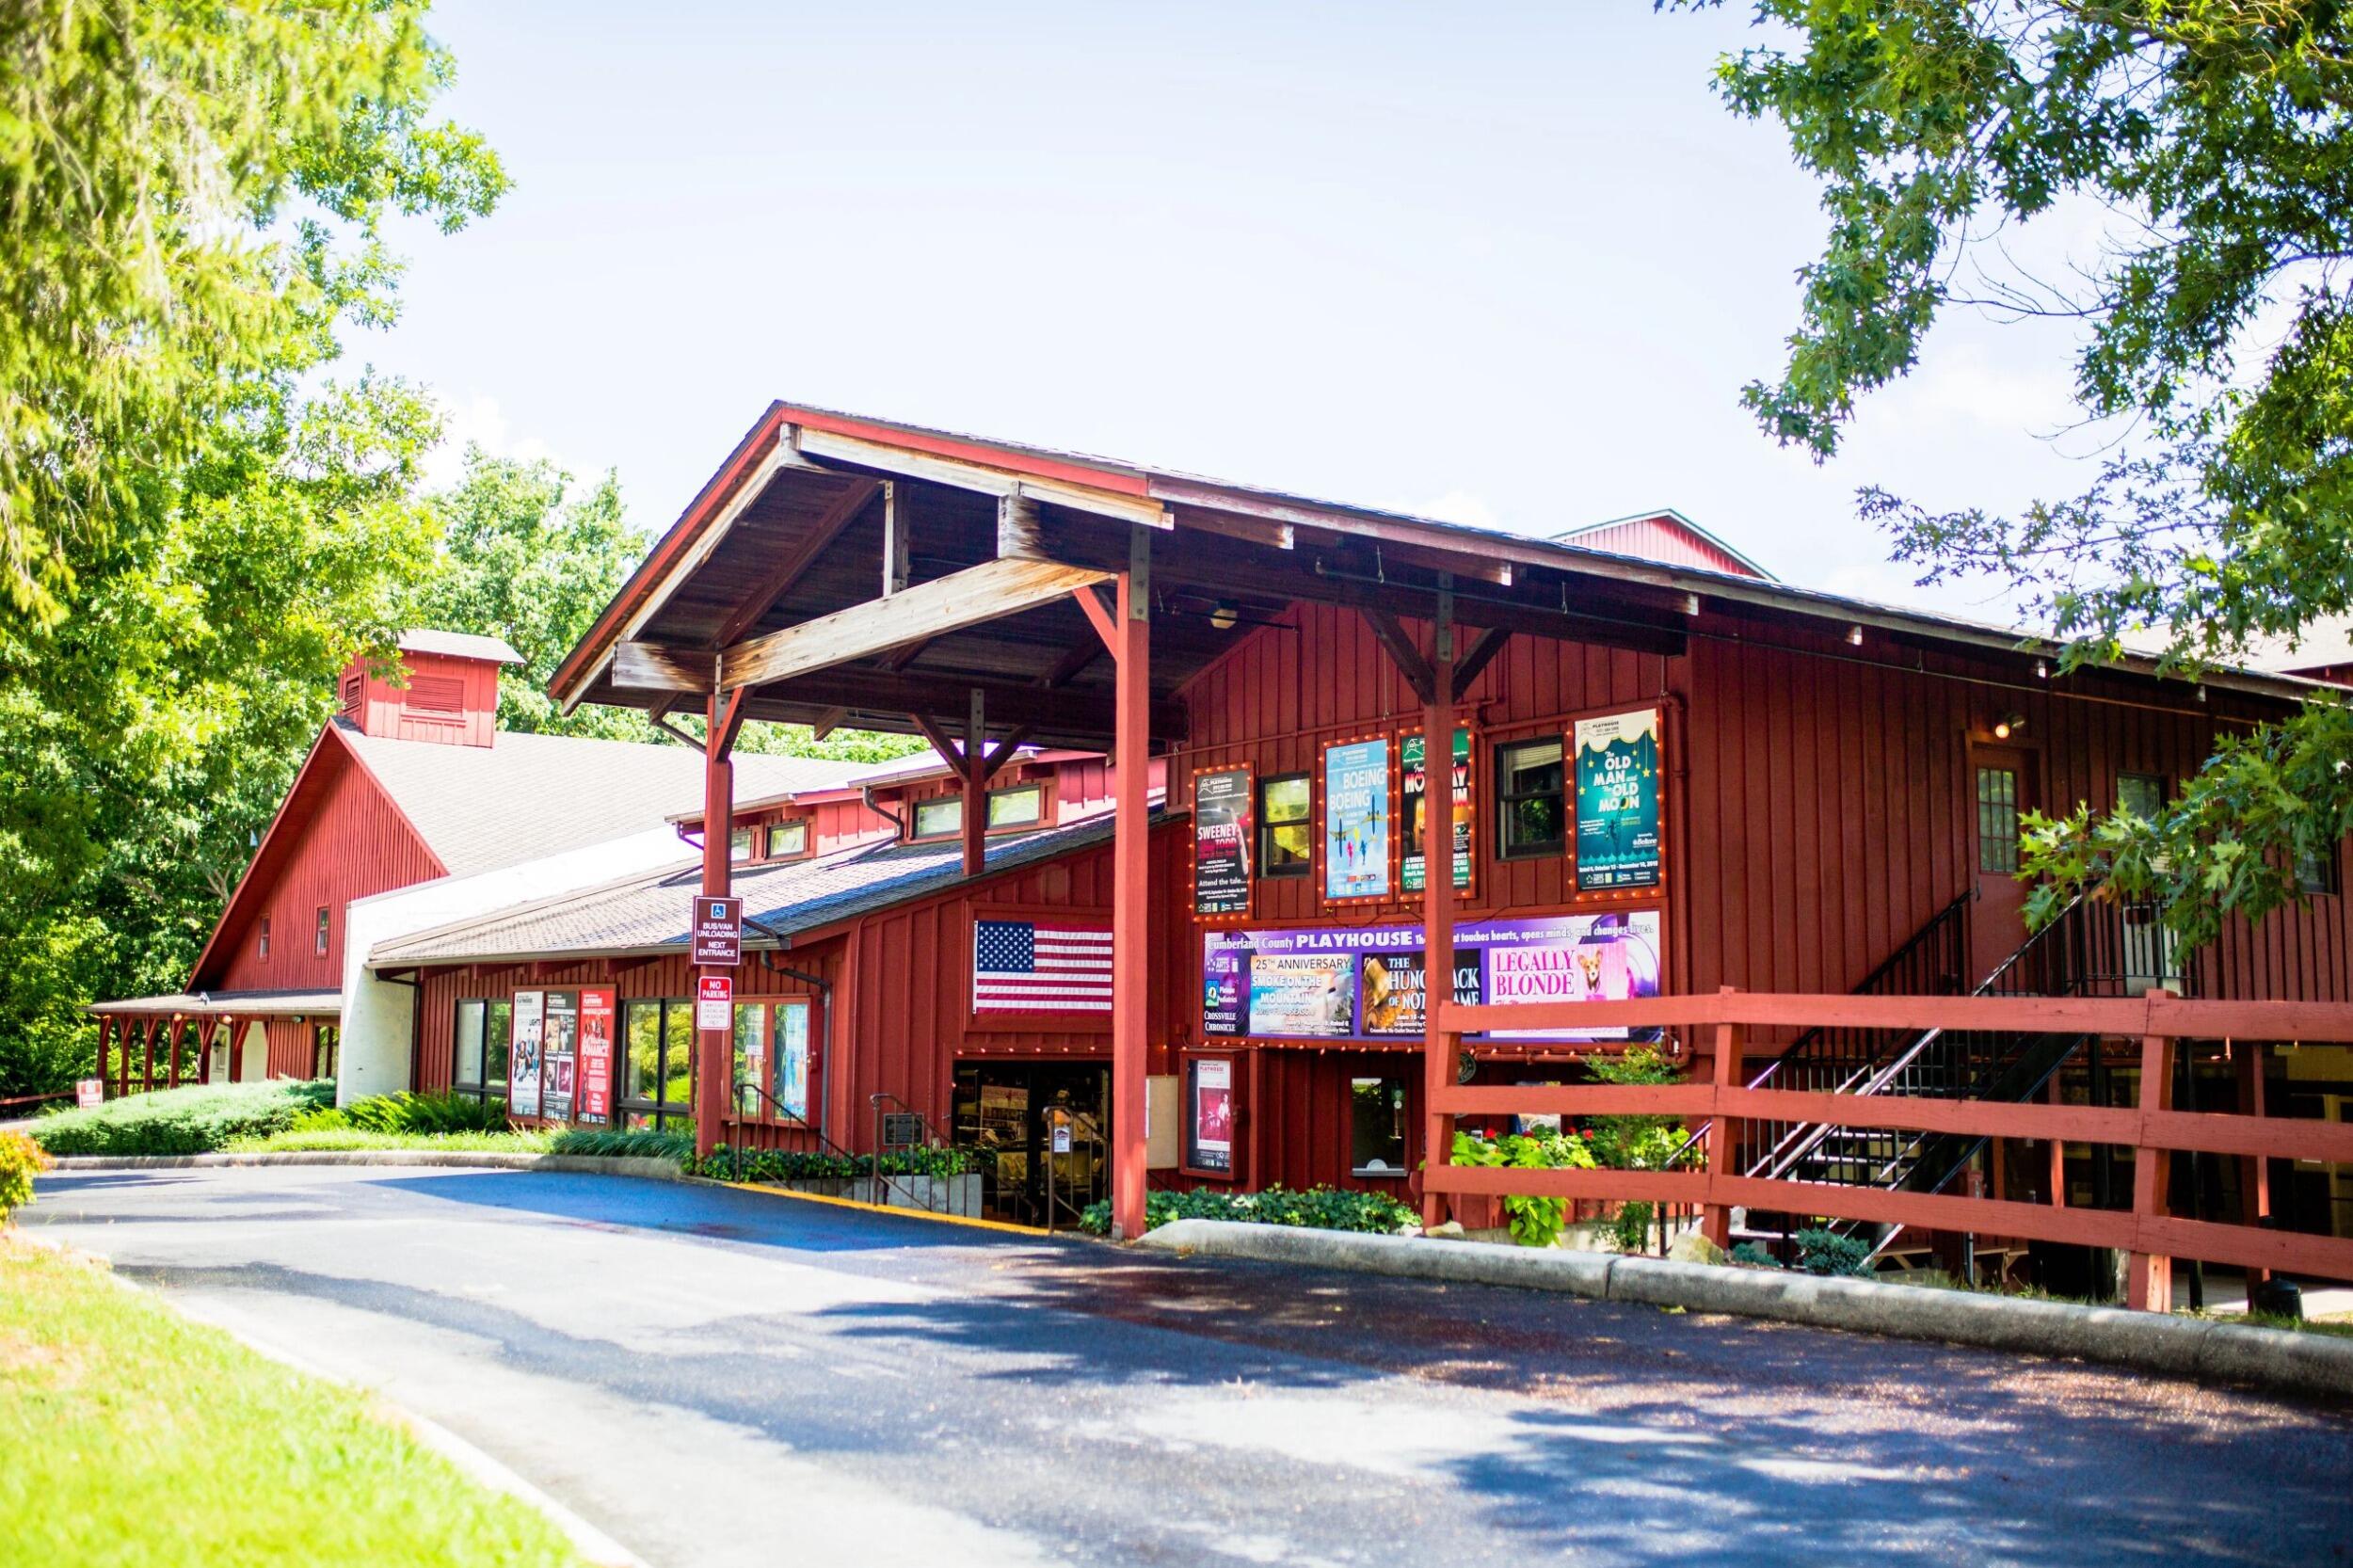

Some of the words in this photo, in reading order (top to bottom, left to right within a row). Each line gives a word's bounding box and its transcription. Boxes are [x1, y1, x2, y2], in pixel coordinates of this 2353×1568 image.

[1605, 756, 1631, 770] OLD
[1343, 767, 1385, 789] BOEING
[1593, 770, 1625, 786] MAN
[1611, 782, 1639, 796] OLD
[1329, 790, 1369, 810] BOEING
[1598, 795, 1640, 812] MOON
[1197, 824, 1237, 840] SWEENEY
[1219, 877, 1228, 886] the
[697, 930, 738, 938] UNLOADING
[1208, 935, 1259, 950] Cumberland
[1262, 936, 1293, 952] County
[1297, 931, 1412, 949] PLAYHOUSE
[1461, 932, 1489, 942] touches
[1491, 929, 1520, 942] hearts,
[1521, 931, 1545, 942] opens
[1593, 923, 1627, 938] changes
[698, 949, 735, 957] ENTRANCE
[1277, 957, 1352, 970] ANNIVERSARY
[1388, 957, 1410, 968] THE
[1496, 950, 1576, 972] LEGALLY
[710, 981, 721, 989] NO
[1252, 976, 1286, 988] SMOKE
[1287, 976, 1301, 988] ON
[1301, 976, 1321, 988] THE
[1496, 973, 1575, 996] BLONDE
[702, 990, 728, 999] PARKING
[1260, 992, 1312, 1004] MOUNTAIN
[1389, 996, 1400, 1006] OF
[1204, 1011, 1237, 1020] CROSSVILLE
[1205, 1022, 1236, 1032] CHRONICLE
